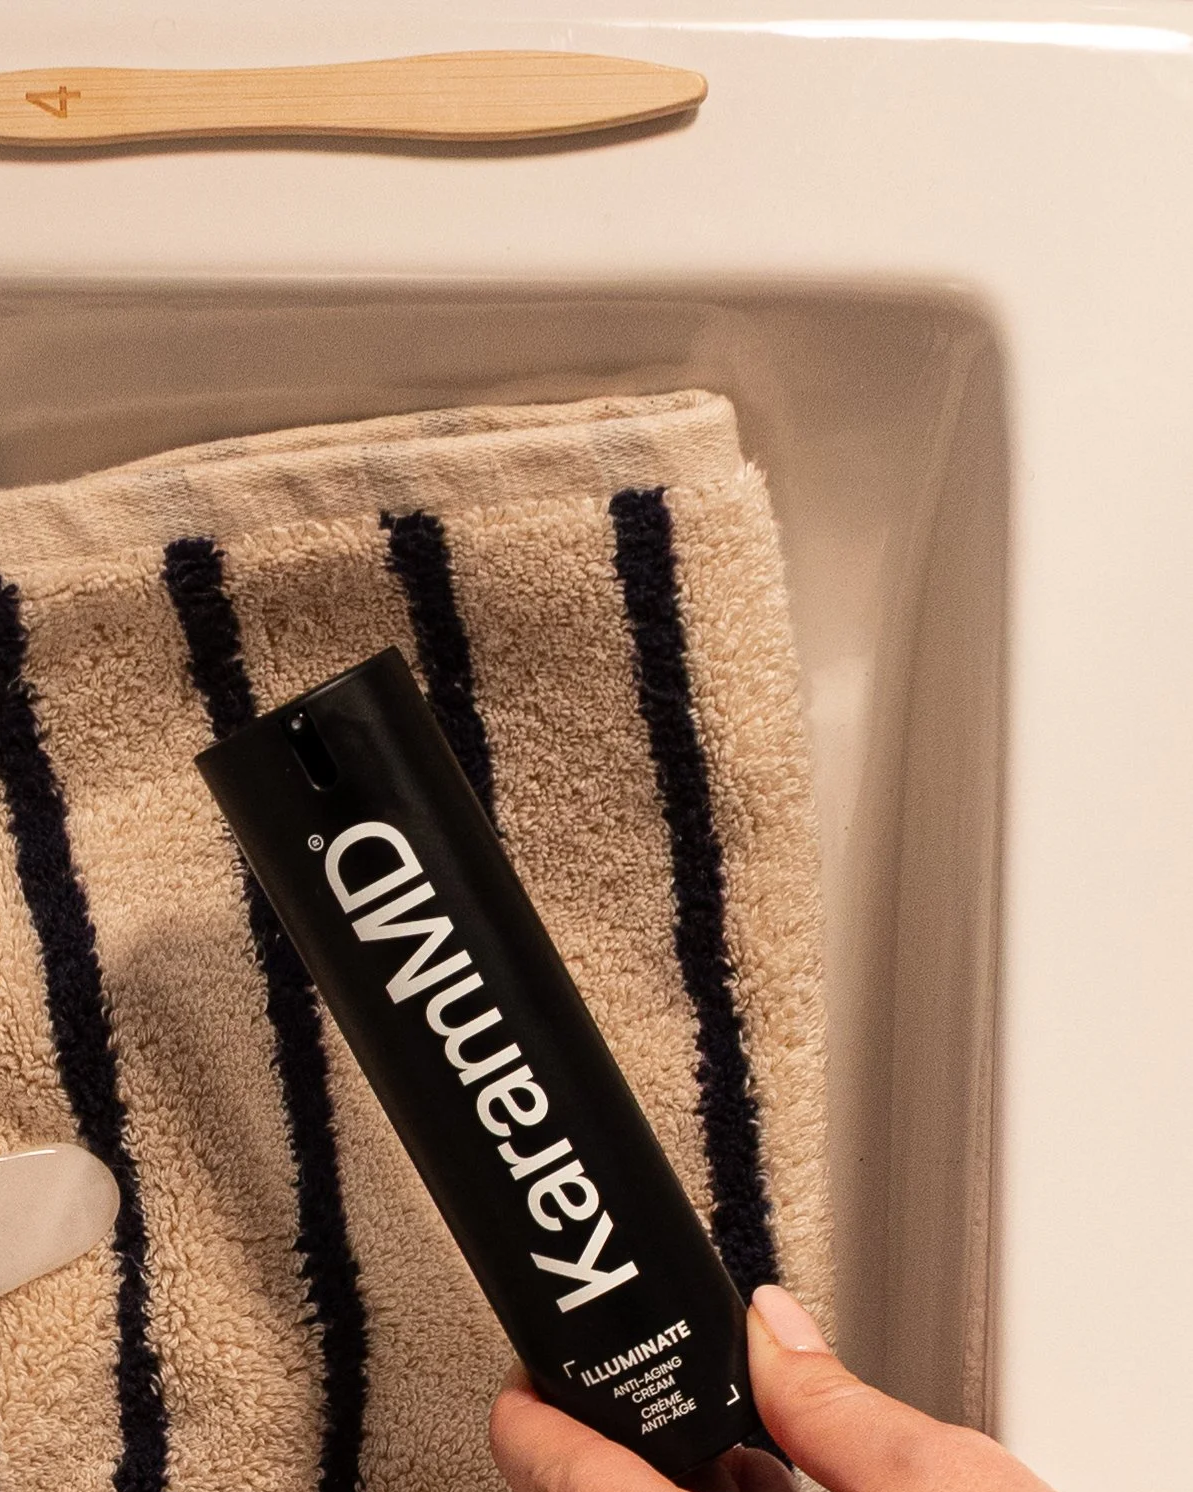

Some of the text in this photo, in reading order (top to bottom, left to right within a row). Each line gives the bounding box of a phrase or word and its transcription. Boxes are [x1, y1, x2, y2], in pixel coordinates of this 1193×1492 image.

[25, 85, 81, 119] 4
[580, 1319, 692, 1387] ILLUMINATE
[612, 1355, 683, 1399] ANTI-AGING
[631, 1375, 676, 1404] CREAM
[640, 1390, 684, 1420] CRÈME
[640, 1397, 697, 1435] ANTI-ÂGE
